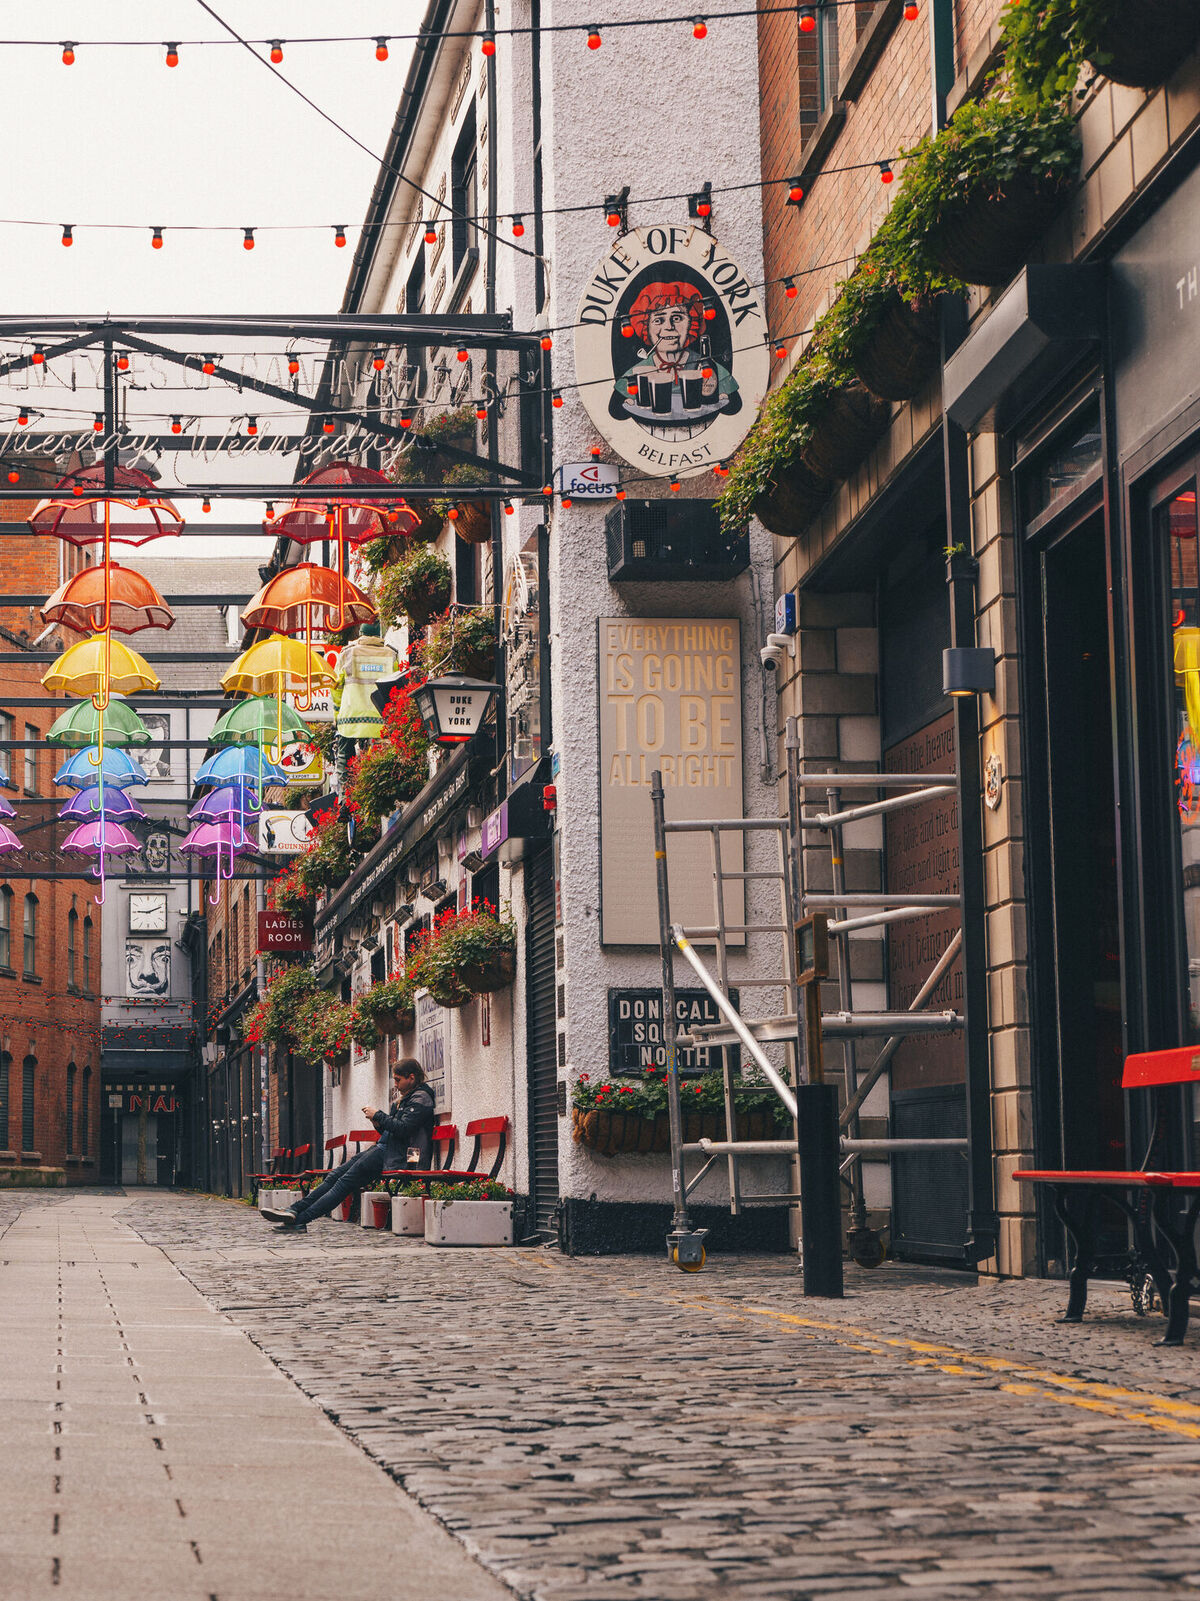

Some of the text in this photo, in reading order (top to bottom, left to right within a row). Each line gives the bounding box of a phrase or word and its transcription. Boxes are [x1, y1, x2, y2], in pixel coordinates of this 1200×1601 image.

[580, 228, 761, 327] DUKE OF YORK
[637, 442, 713, 468] BELFAST
[570, 478, 613, 494] focus
[606, 624, 734, 650] EVERYTHING
[607, 653, 734, 691] IS GOING
[450, 696, 472, 704] DUKE
[448, 717, 471, 725] YORK
[455, 707, 466, 715] OF
[607, 693, 735, 752] TO BE
[609, 754, 735, 787] ALL RIGHT
[265, 920, 304, 929] LADIES
[268, 934, 302, 942] ROOM
